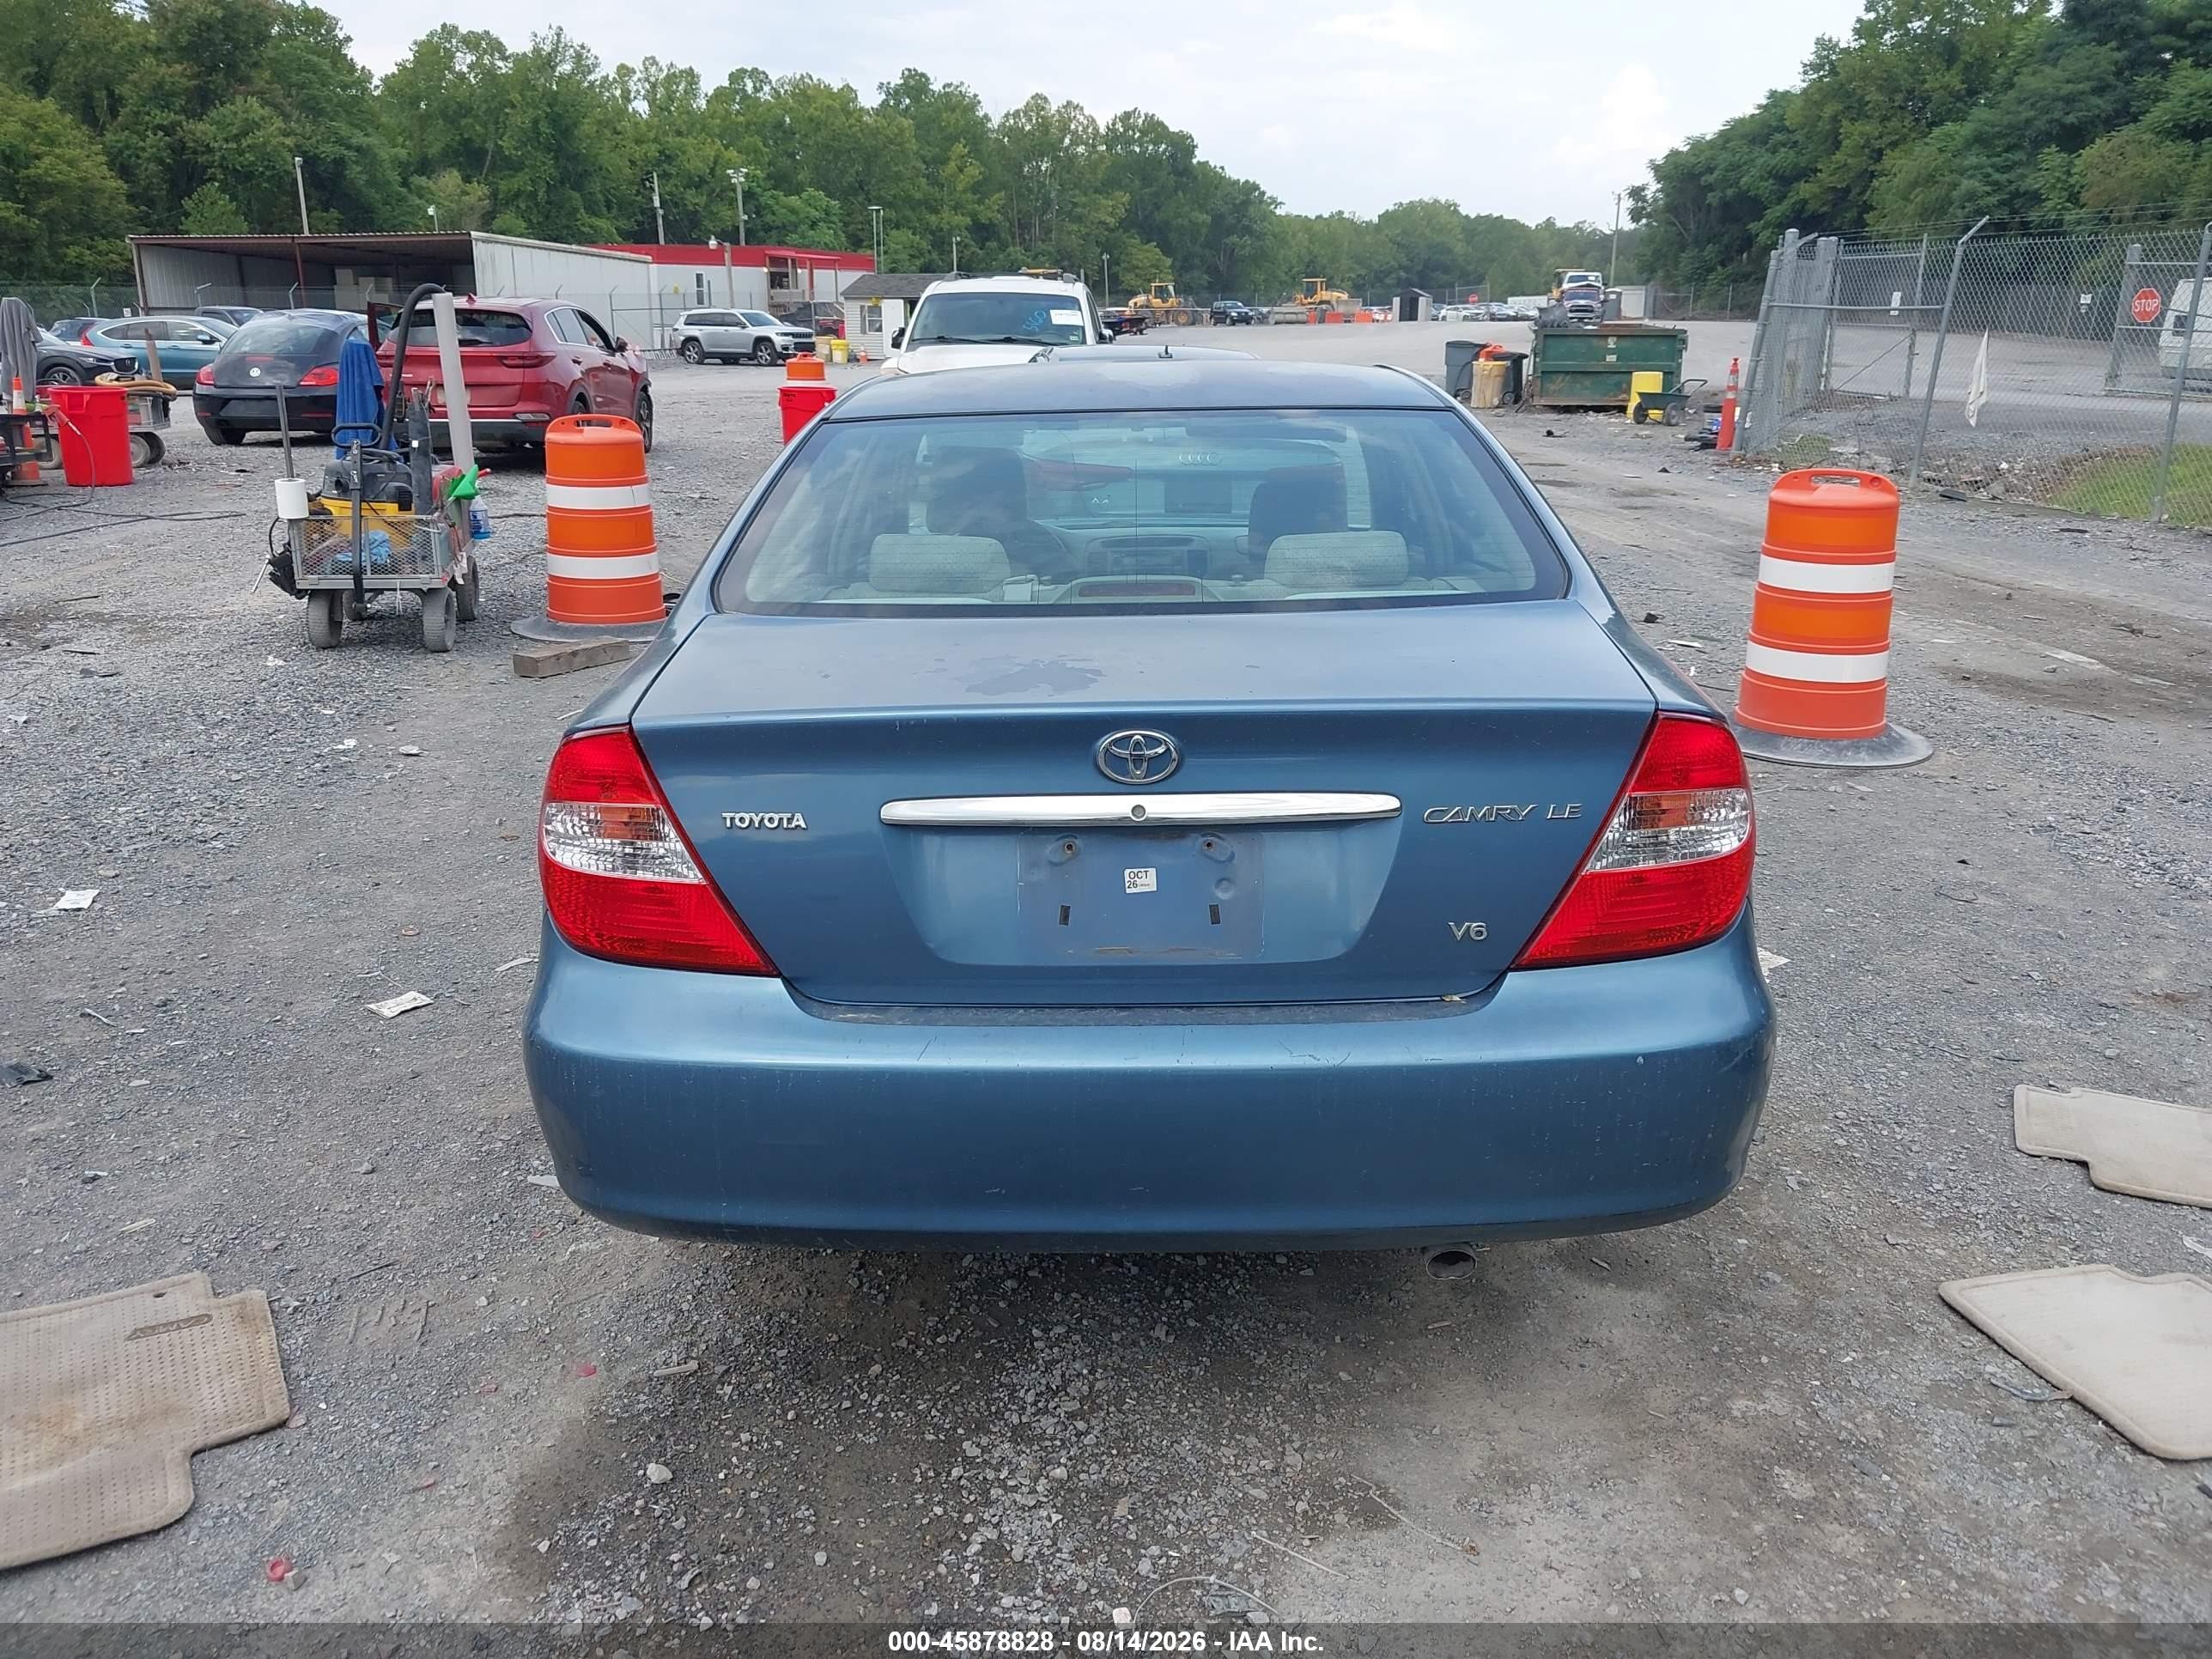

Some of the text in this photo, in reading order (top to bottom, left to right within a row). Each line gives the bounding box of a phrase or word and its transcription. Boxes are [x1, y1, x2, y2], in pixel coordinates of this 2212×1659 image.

[2134, 299, 2159, 312] STOP
[721, 812, 807, 829] TOYOTA
[1423, 803, 1584, 823] CAMRY LE
[1128, 870, 1150, 880] OCT
[1127, 879, 1138, 889] 26
[1448, 921, 1489, 942] V6
